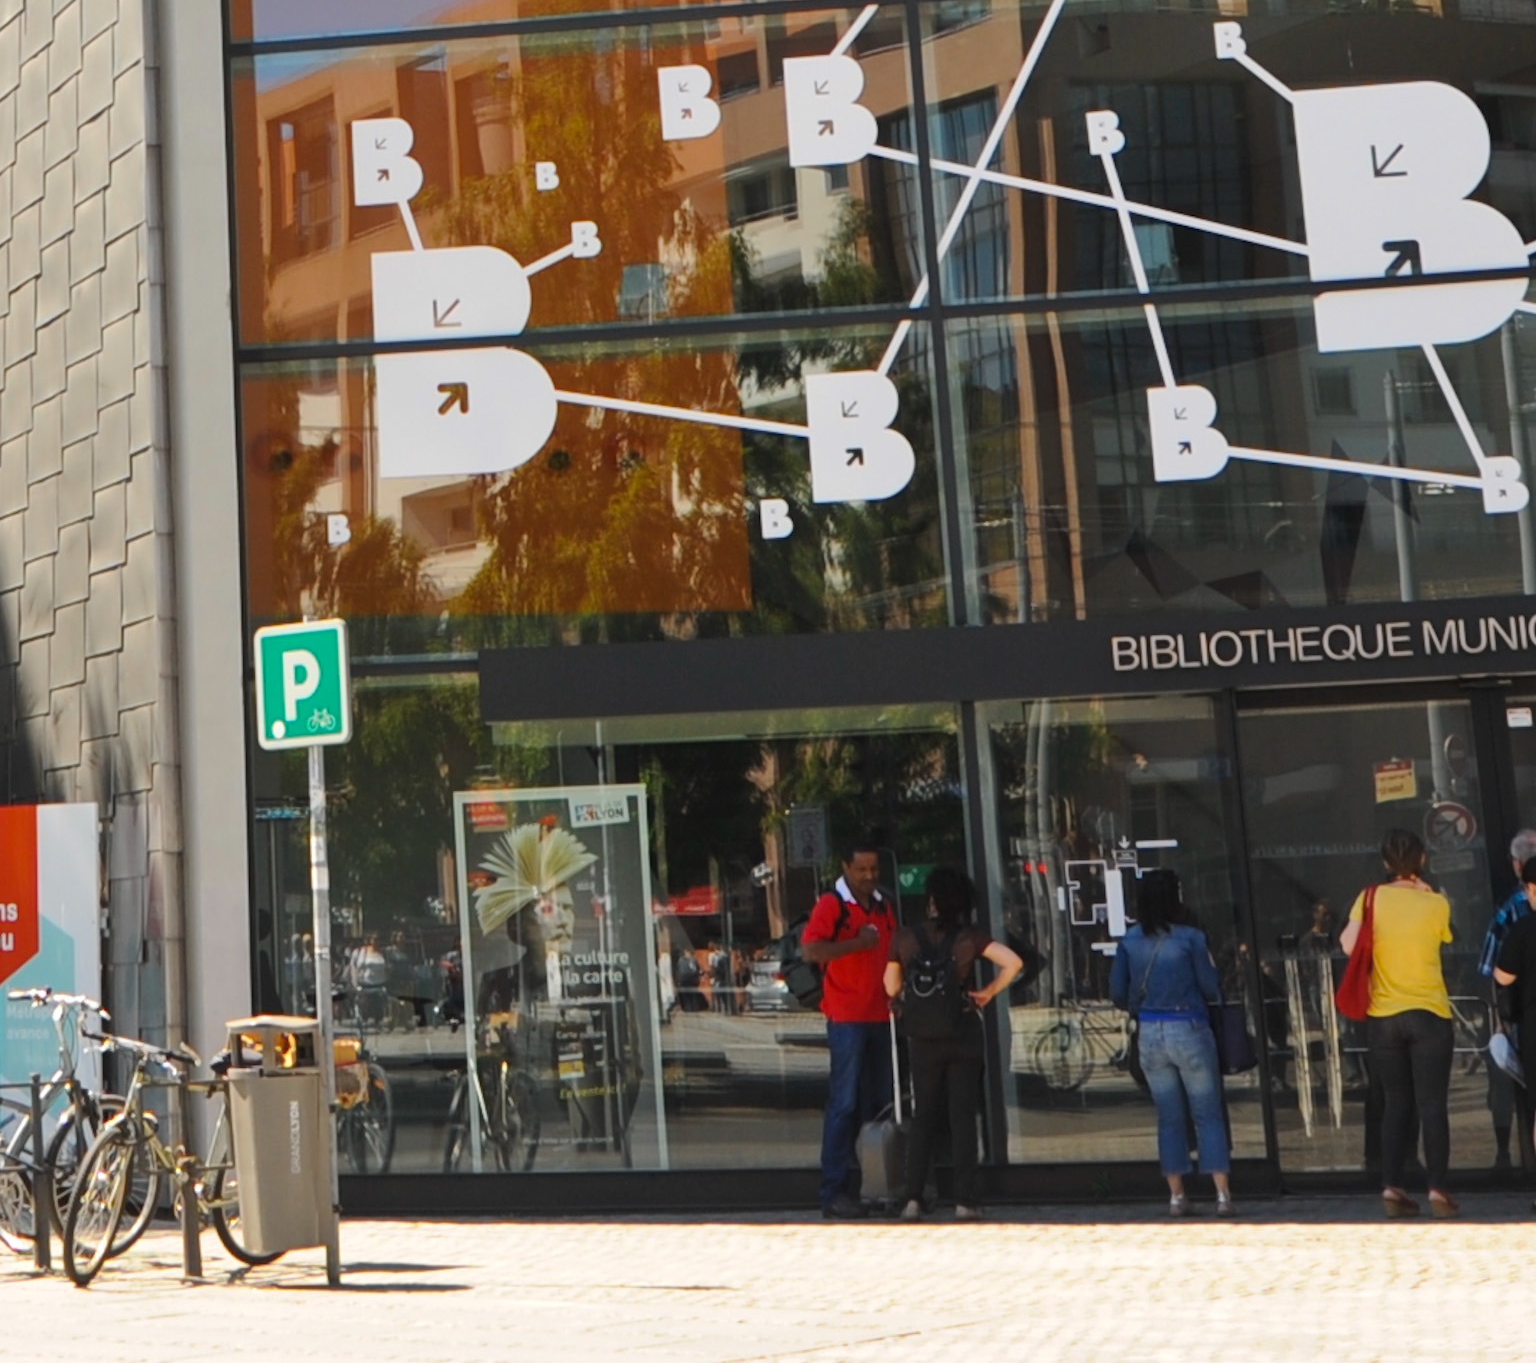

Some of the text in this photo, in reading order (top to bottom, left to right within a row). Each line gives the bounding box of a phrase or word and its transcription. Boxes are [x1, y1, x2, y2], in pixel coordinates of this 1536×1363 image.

[1213, 22, 1247, 60] B
[658, 64, 721, 141] B
[783, 55, 878, 168] B
[1086, 111, 1125, 156] B
[352, 117, 424, 207] B
[536, 162, 560, 191] B
[571, 221, 602, 258] B
[1293, 81, 1528, 352] B
[371, 246, 558, 477] B
[806, 370, 916, 504] B
[1147, 385, 1229, 481] B
[1482, 455, 1529, 514] B
[328, 515, 351, 546] B
[760, 498, 793, 539] B
[1111, 623, 1413, 671] BIBLIOTHEQUE
[282, 649, 320, 722] P
[574, 950, 629, 966] culture
[584, 970, 623, 985] carte
